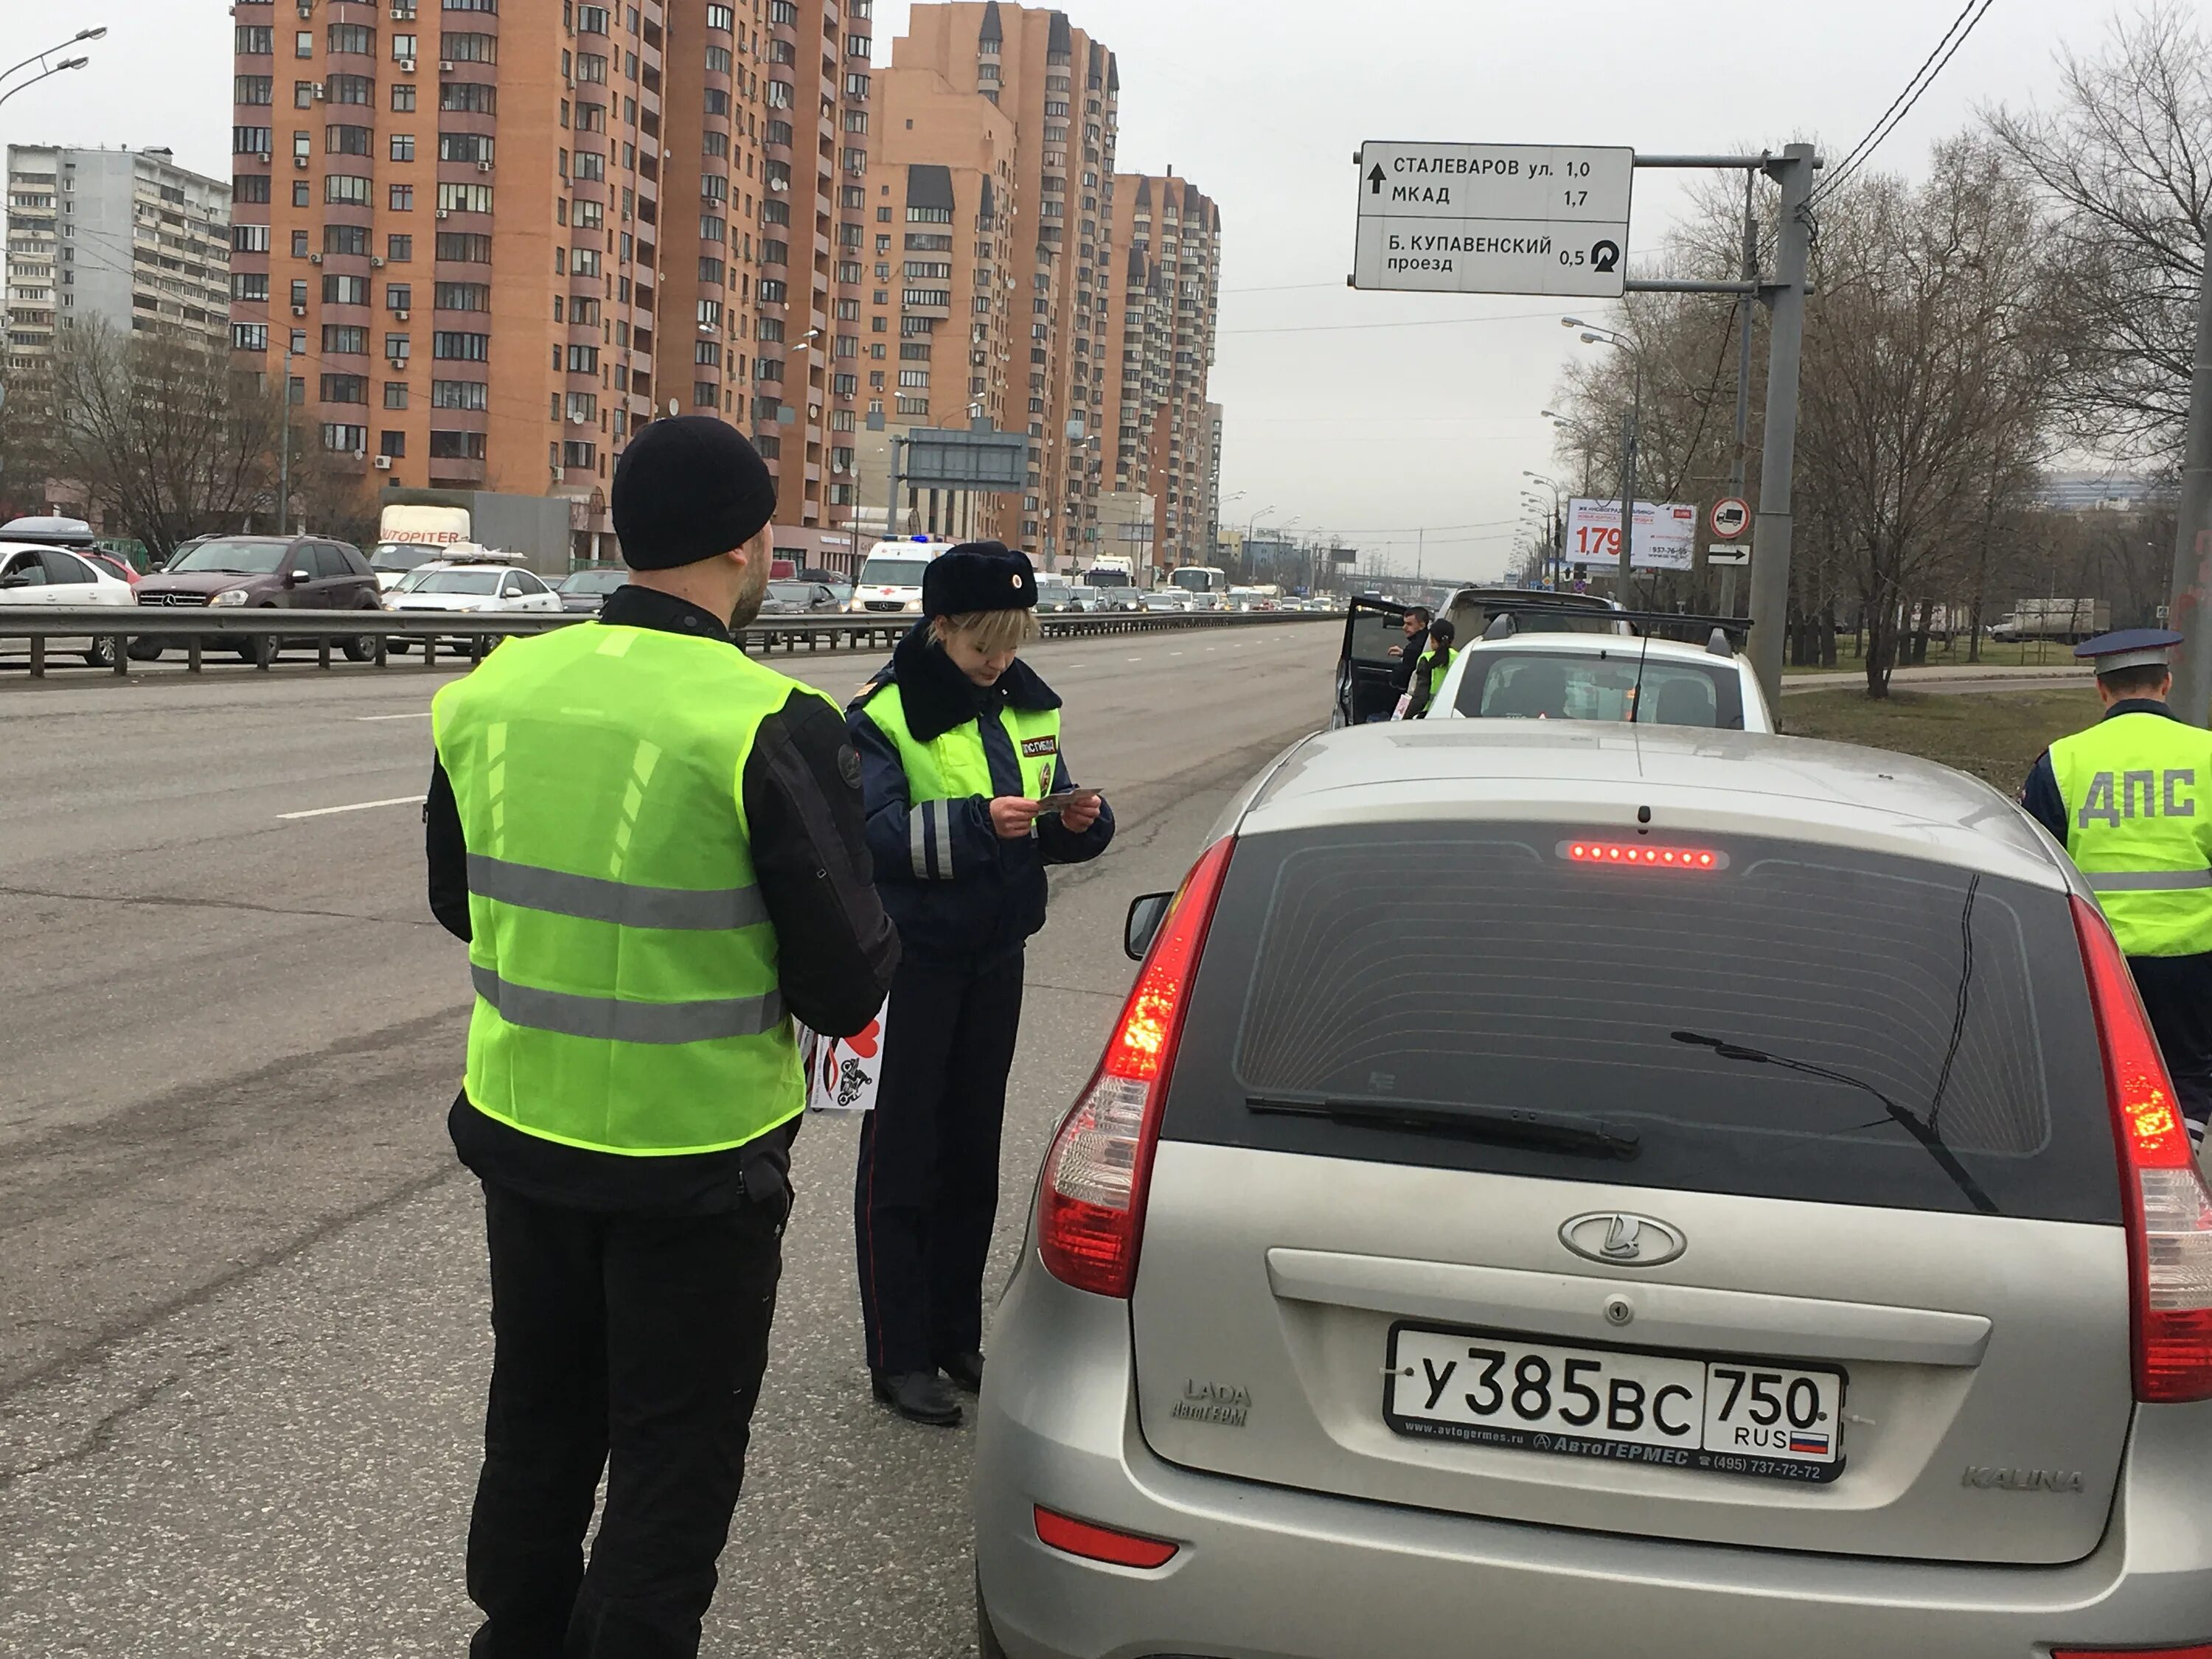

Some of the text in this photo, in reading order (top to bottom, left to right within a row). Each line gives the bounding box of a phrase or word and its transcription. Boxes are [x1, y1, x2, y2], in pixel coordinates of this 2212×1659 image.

[1393, 157, 1590, 179] СТАЛЕВАРОВ ул. 1,0
[1392, 186, 1588, 208] МКАД 1,7
[1389, 234, 1585, 267] Б. КУПАВЕНСКИЙ 0,5
[1388, 257, 1453, 273] проезд
[2078, 768, 2195, 829] ДПС
[1183, 1376, 1253, 1408] LADA
[1422, 1347, 1820, 1437] У385ВС 750
[1405, 1421, 1524, 1444] www.avtogermes.ru
[1734, 1426, 1787, 1449] RUS
[1714, 1455, 1820, 1479] (495) 737-72-72
[1961, 1465, 2084, 1494] KALINA
